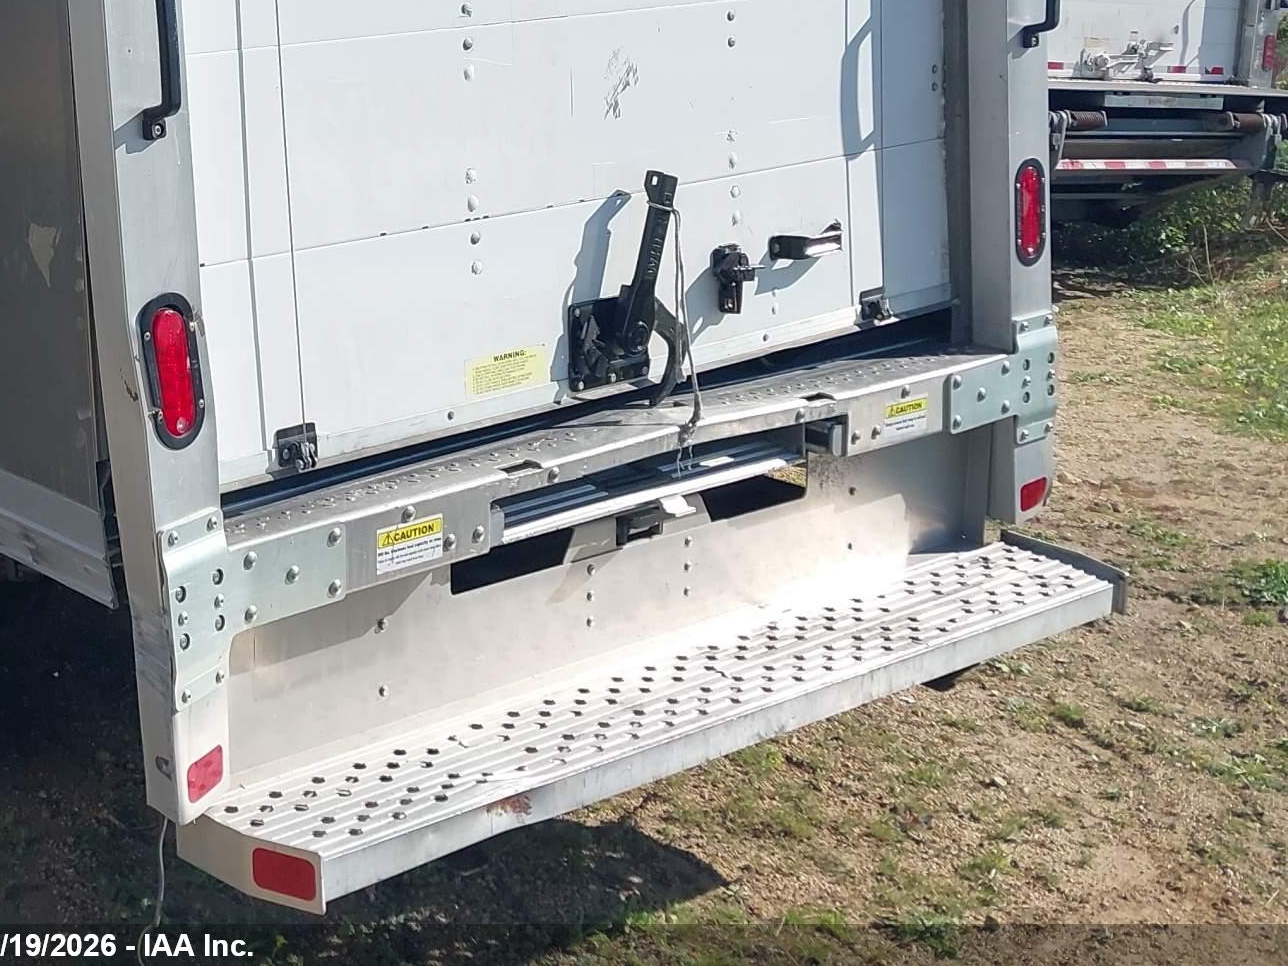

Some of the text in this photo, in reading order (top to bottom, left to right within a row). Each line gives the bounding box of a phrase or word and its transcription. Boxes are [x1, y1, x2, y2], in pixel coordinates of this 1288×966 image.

[493, 349, 527, 362] WARNING:
[895, 402, 923, 414] CAUTION
[393, 523, 434, 542] CAUTION
